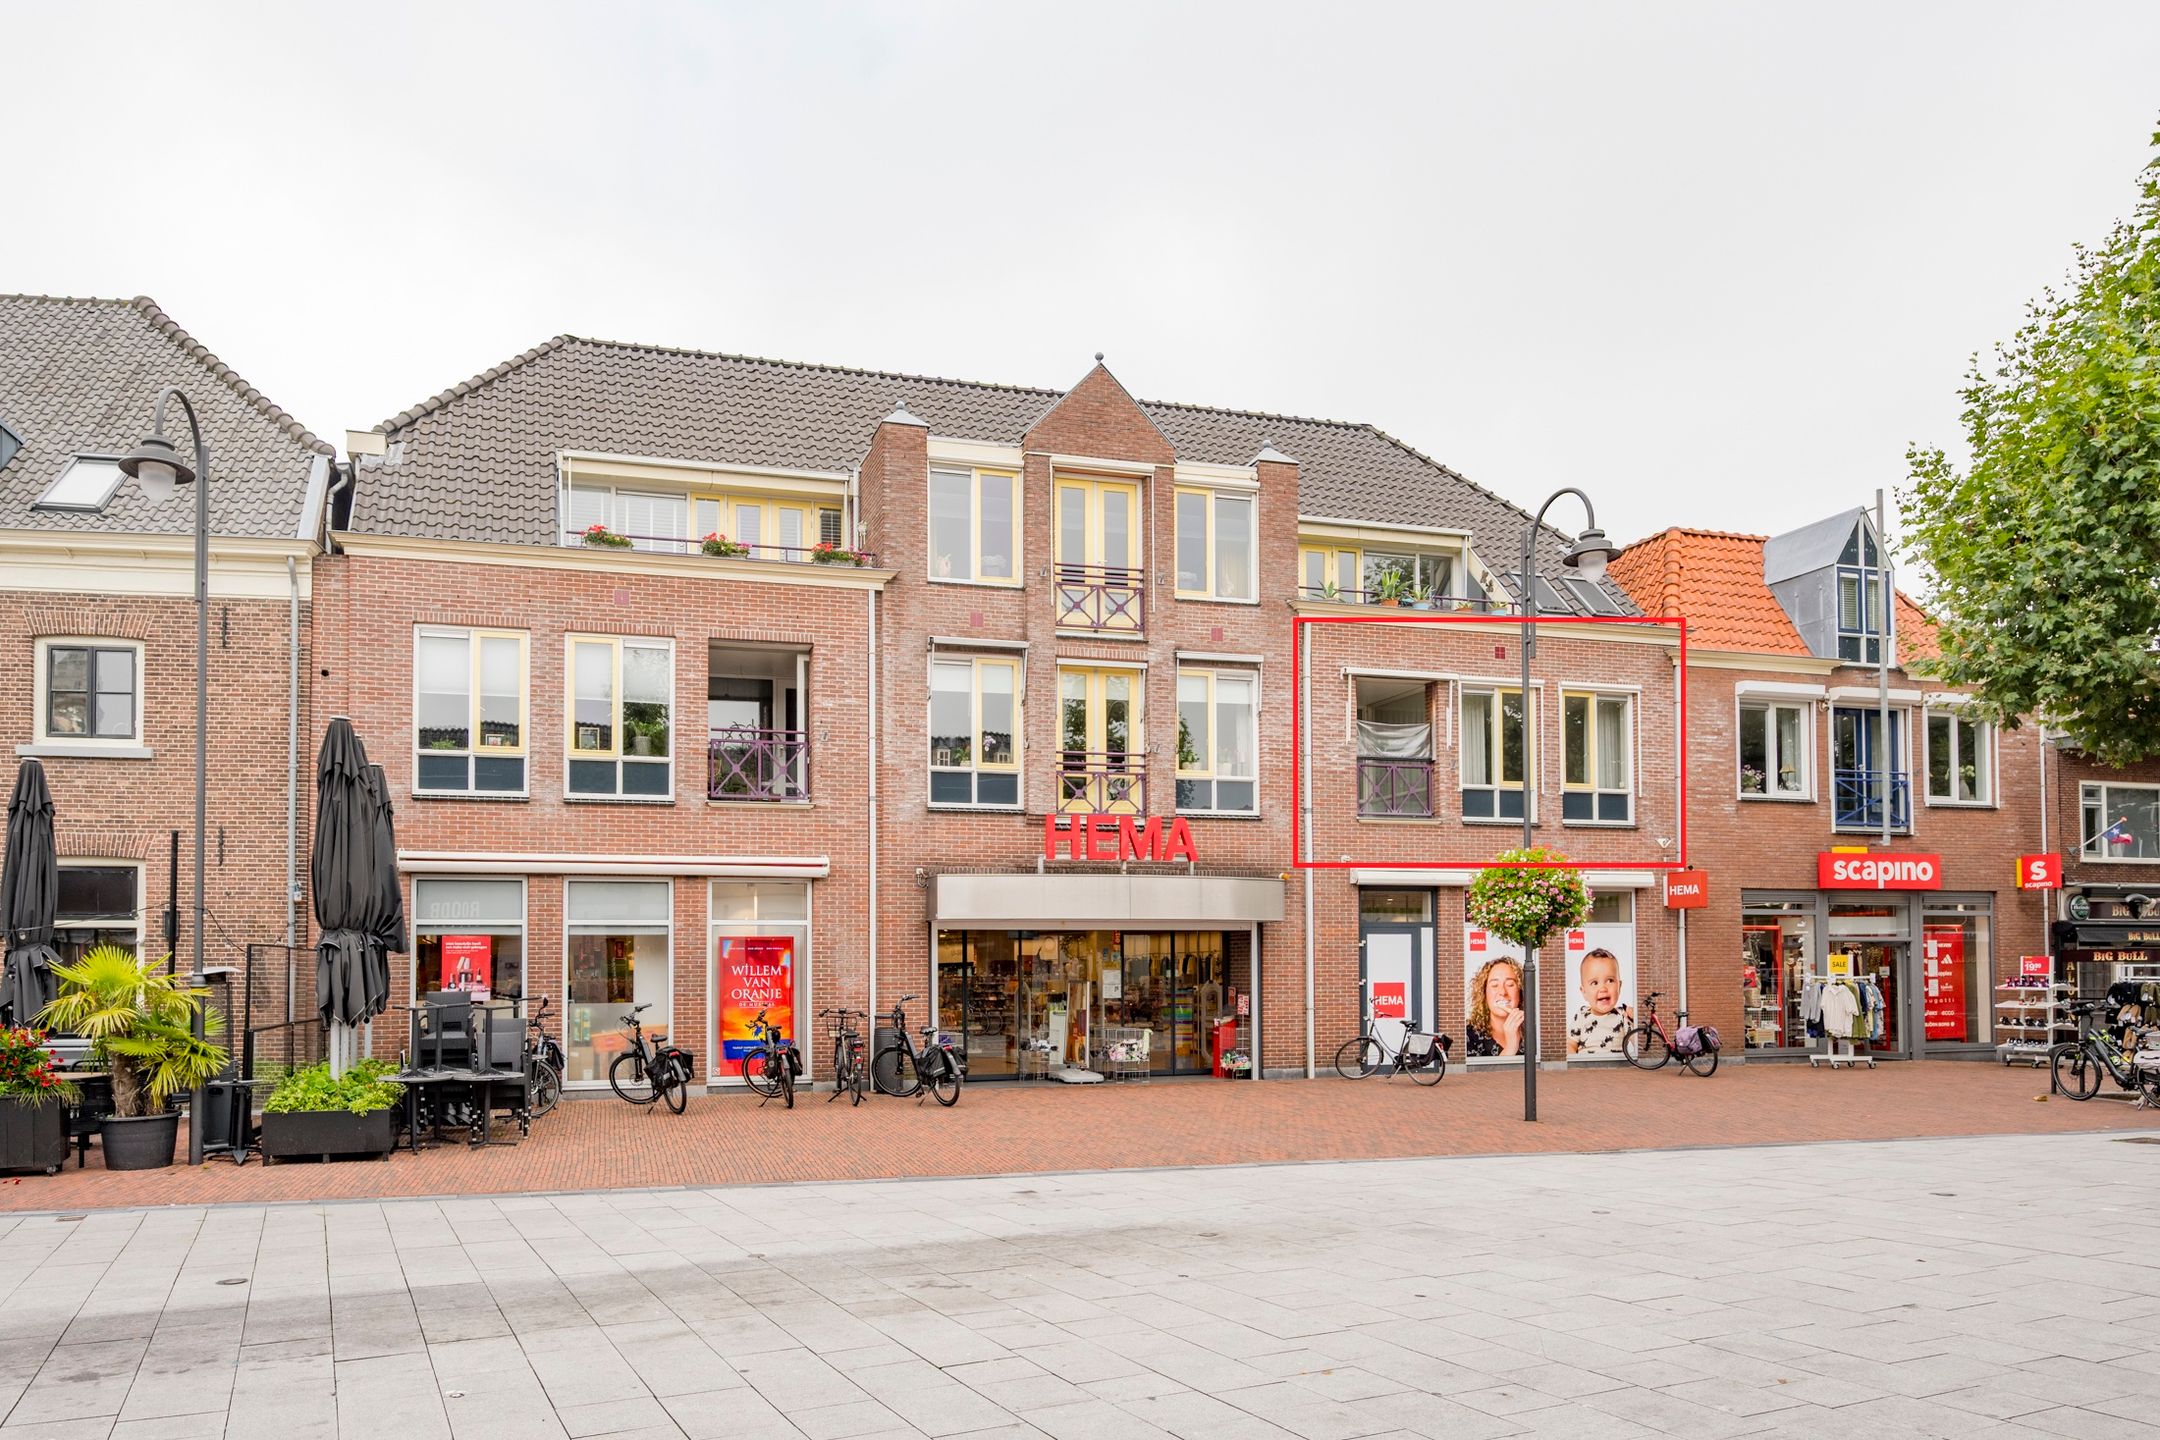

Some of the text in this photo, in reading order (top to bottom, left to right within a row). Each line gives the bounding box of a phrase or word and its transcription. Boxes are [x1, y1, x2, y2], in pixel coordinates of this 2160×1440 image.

[1045, 813, 1199, 862] HEMA
[1833, 860, 1933, 889] scapino
[1669, 884, 1700, 895] HEMA
[2024, 880, 2053, 889] scapino
[2093, 951, 2148, 961] BIG BULL
[731, 963, 782, 976] WILLEM
[743, 977, 770, 988] VAN
[731, 988, 782, 1002] ORANJE
[1375, 995, 1404, 1006] HEMA
